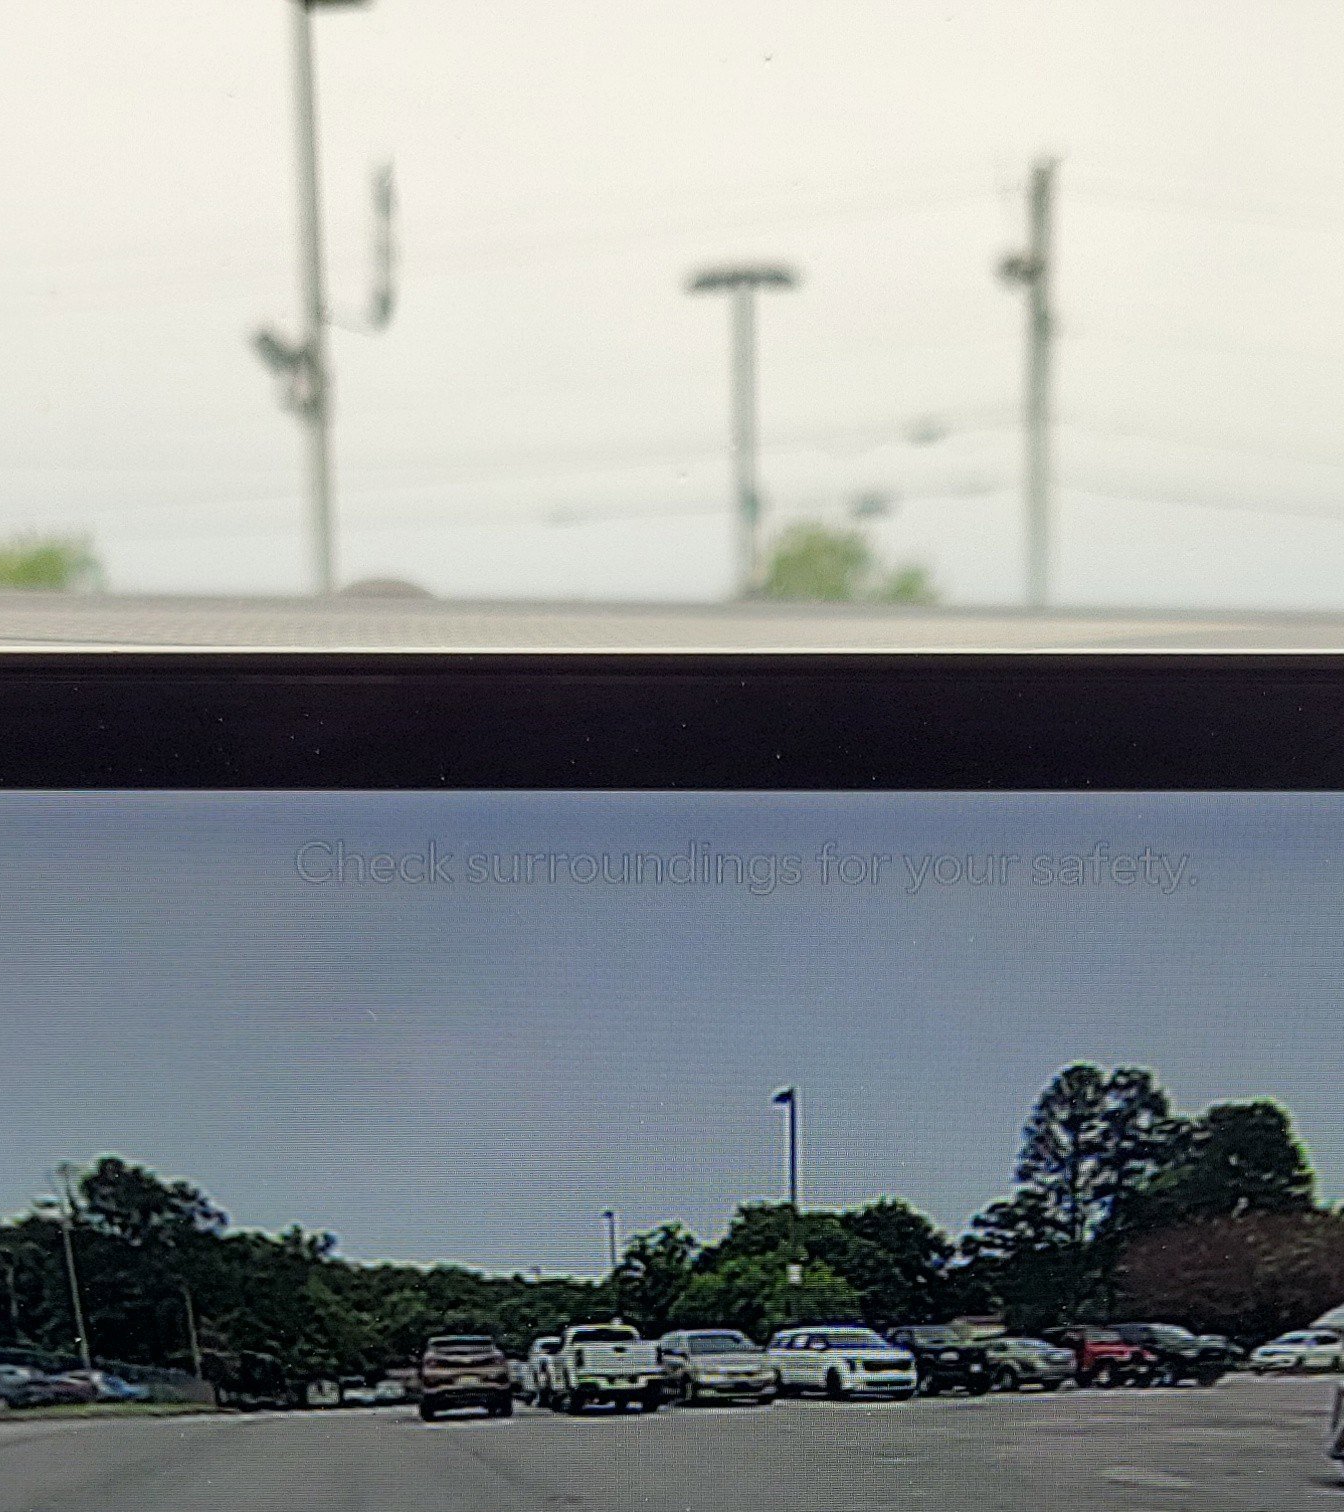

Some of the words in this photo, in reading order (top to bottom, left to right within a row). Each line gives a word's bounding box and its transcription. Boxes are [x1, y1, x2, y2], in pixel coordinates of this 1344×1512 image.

[294, 839, 455, 885] Check
[465, 839, 802, 896] surroundings
[818, 840, 890, 886] for
[903, 850, 1020, 896] your
[1031, 840, 1199, 896] safety.
